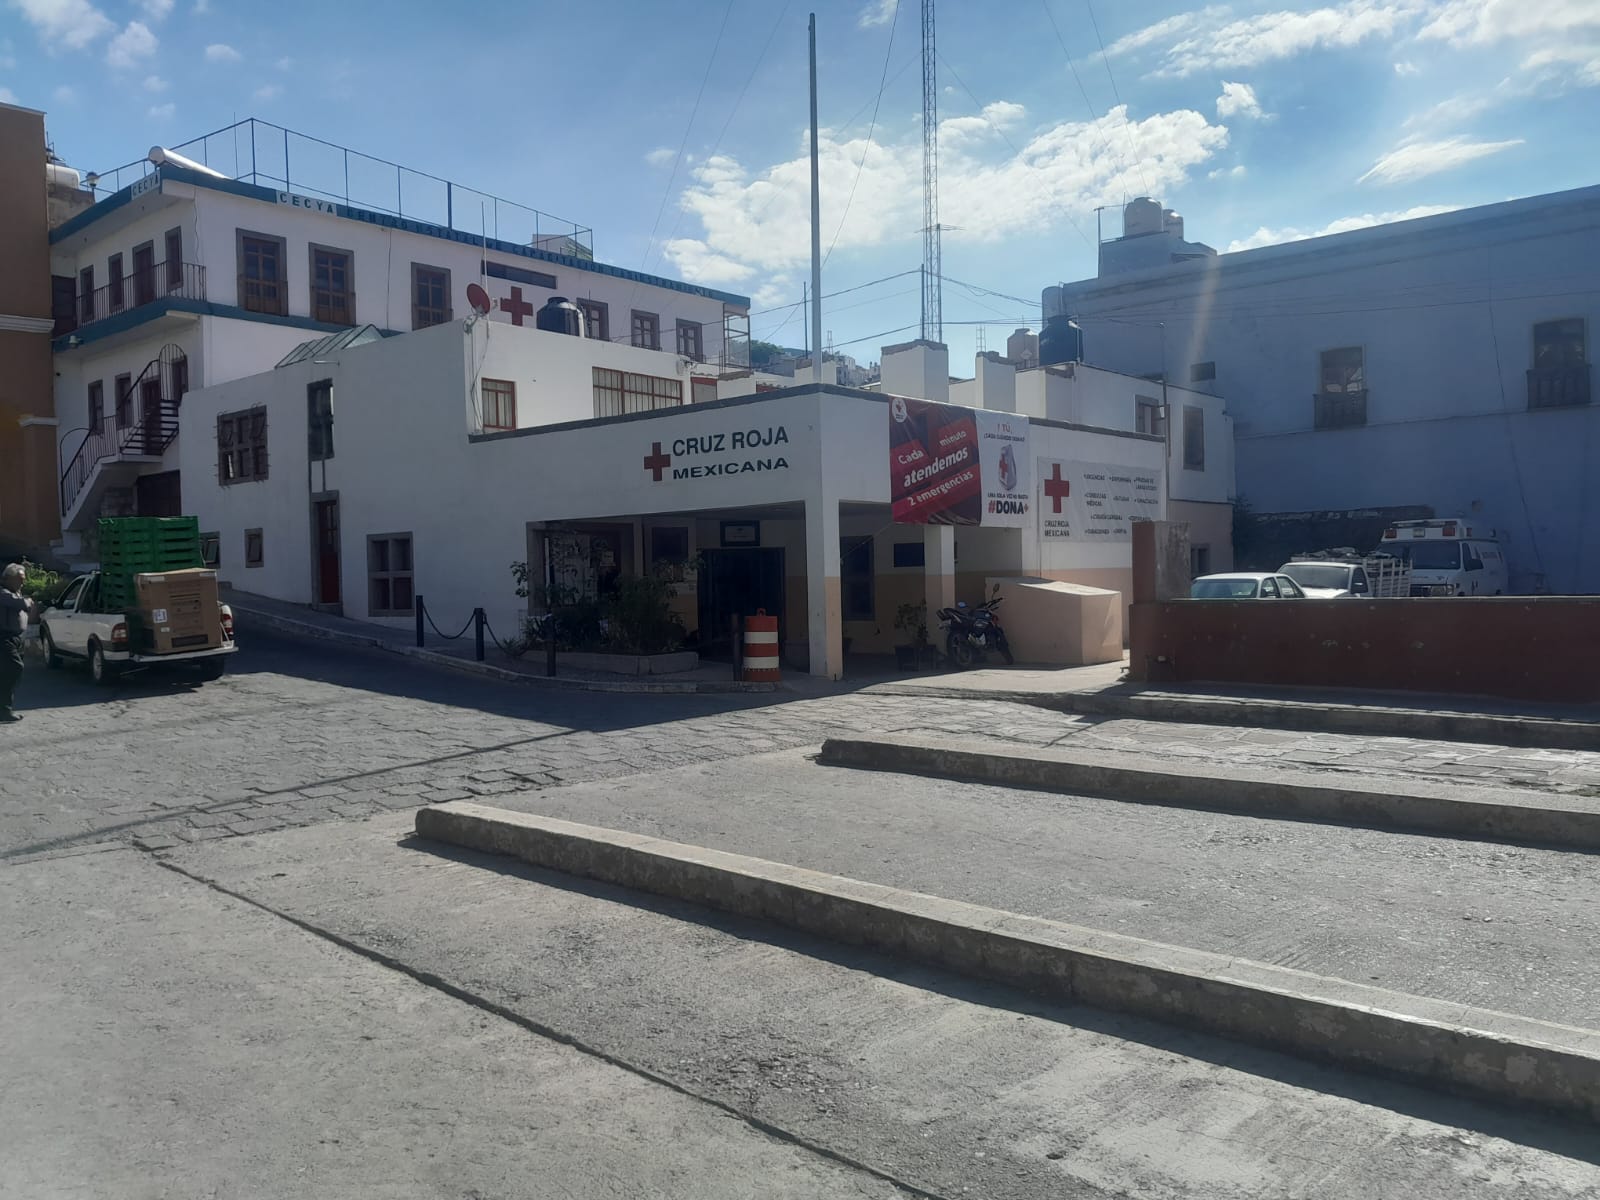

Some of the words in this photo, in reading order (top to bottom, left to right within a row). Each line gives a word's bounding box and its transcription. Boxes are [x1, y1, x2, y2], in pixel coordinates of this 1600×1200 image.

[132, 174, 160, 197] CECYA
[279, 192, 335, 214] CECYA
[672, 433, 726, 457] CRUZ
[731, 426, 790, 450] ROJA
[898, 449, 925, 465] Cada
[938, 430, 968, 448] minuto
[672, 457, 790, 480] MEXICANA
[903, 446, 969, 488] atendemos
[907, 496, 917, 507] 2
[917, 470, 974, 503] emergencias
